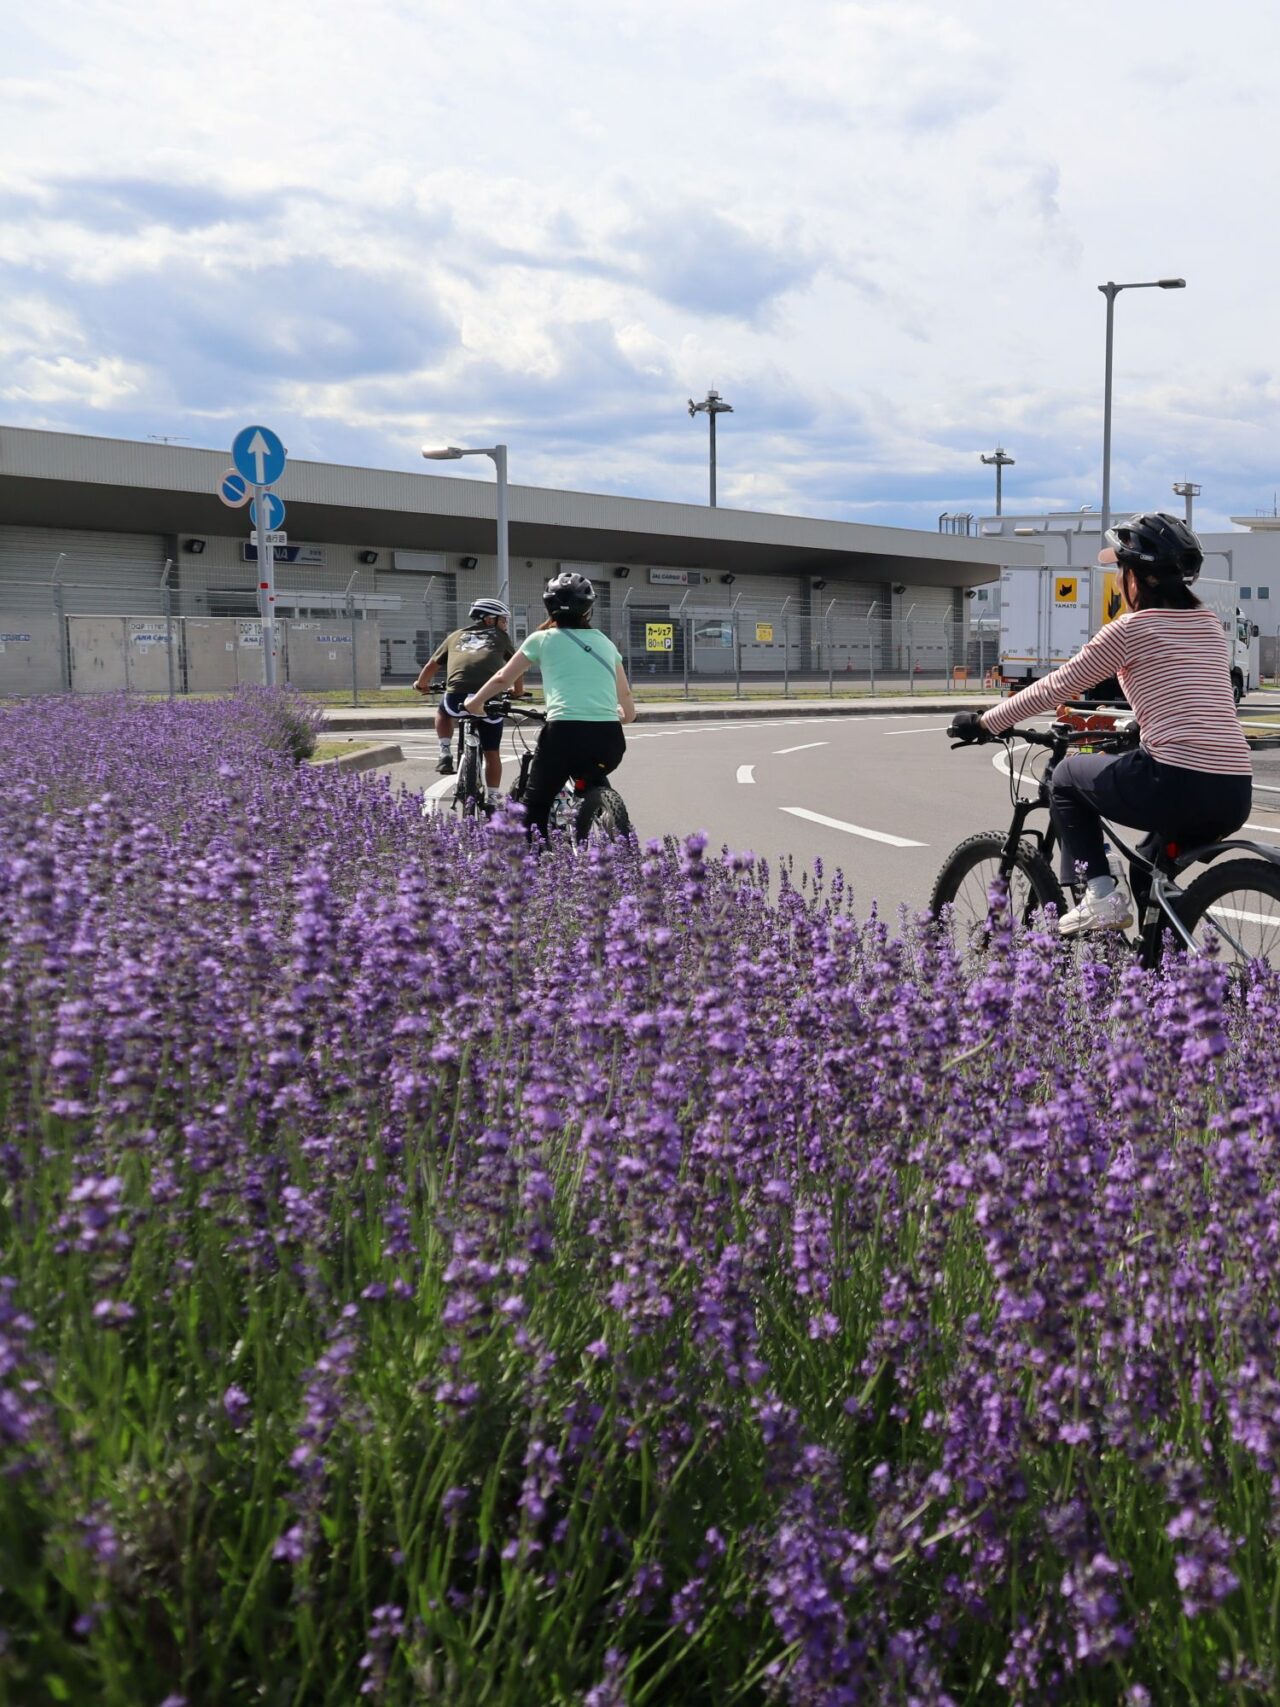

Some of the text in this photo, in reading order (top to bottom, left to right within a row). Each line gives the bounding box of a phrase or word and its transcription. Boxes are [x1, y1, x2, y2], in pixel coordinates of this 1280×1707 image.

[251, 534, 285, 543] 一通行路
[648, 626, 671, 636] カーシェア
